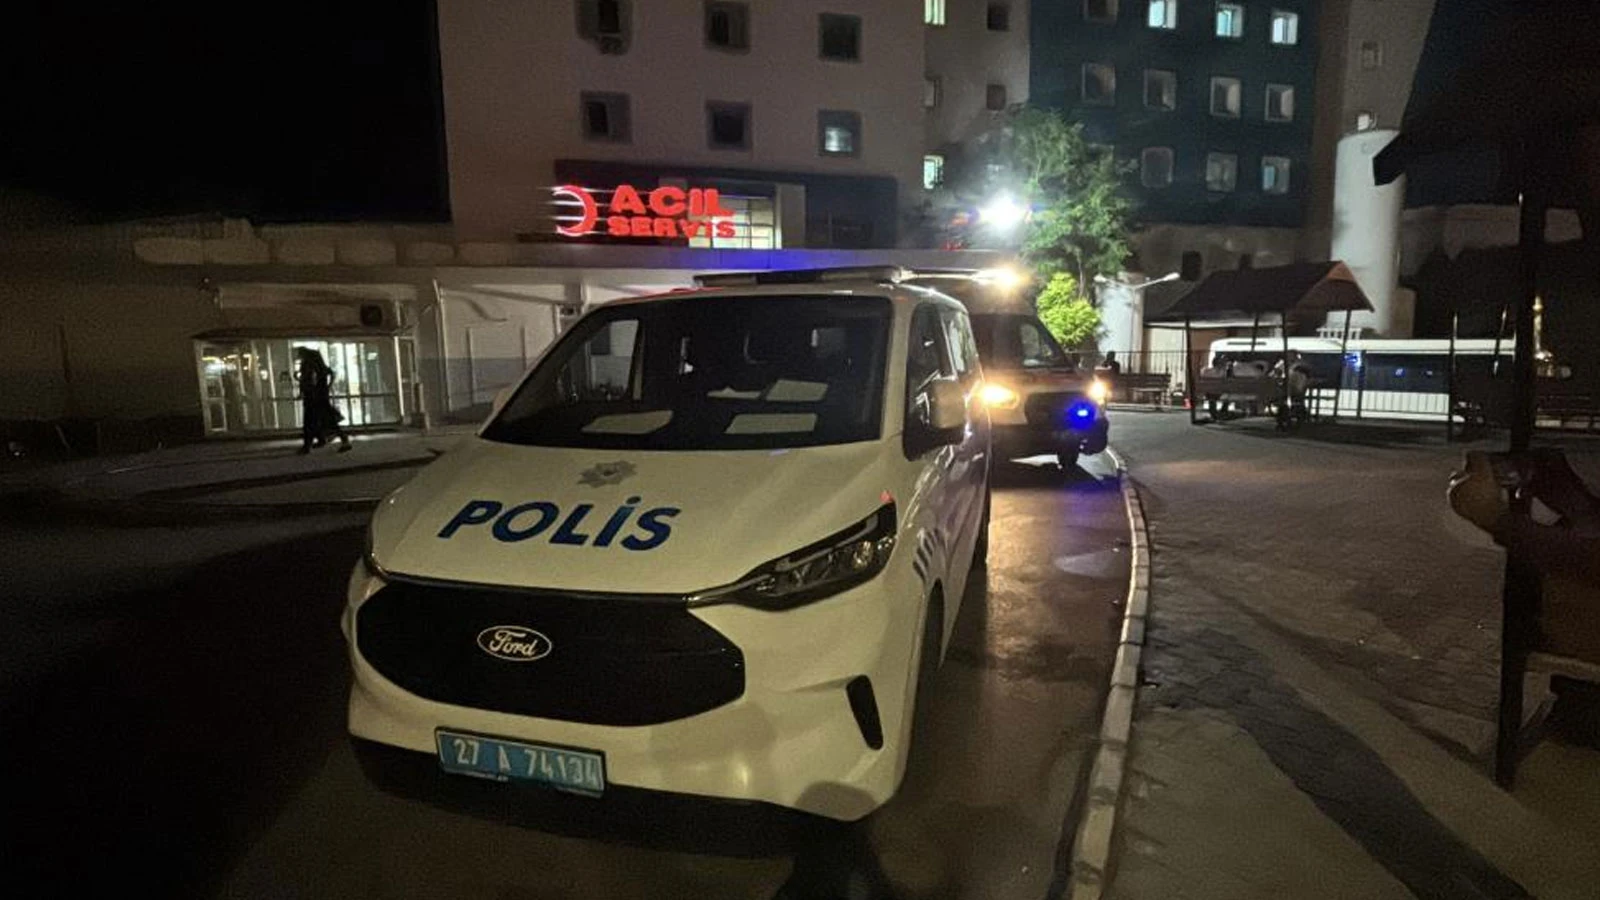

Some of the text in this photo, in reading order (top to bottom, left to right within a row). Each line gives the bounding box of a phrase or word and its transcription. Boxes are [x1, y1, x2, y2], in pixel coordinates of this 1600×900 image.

[437, 496, 681, 551] POLİS
[489, 630, 538, 657] Ford
[453, 738, 480, 766] 27
